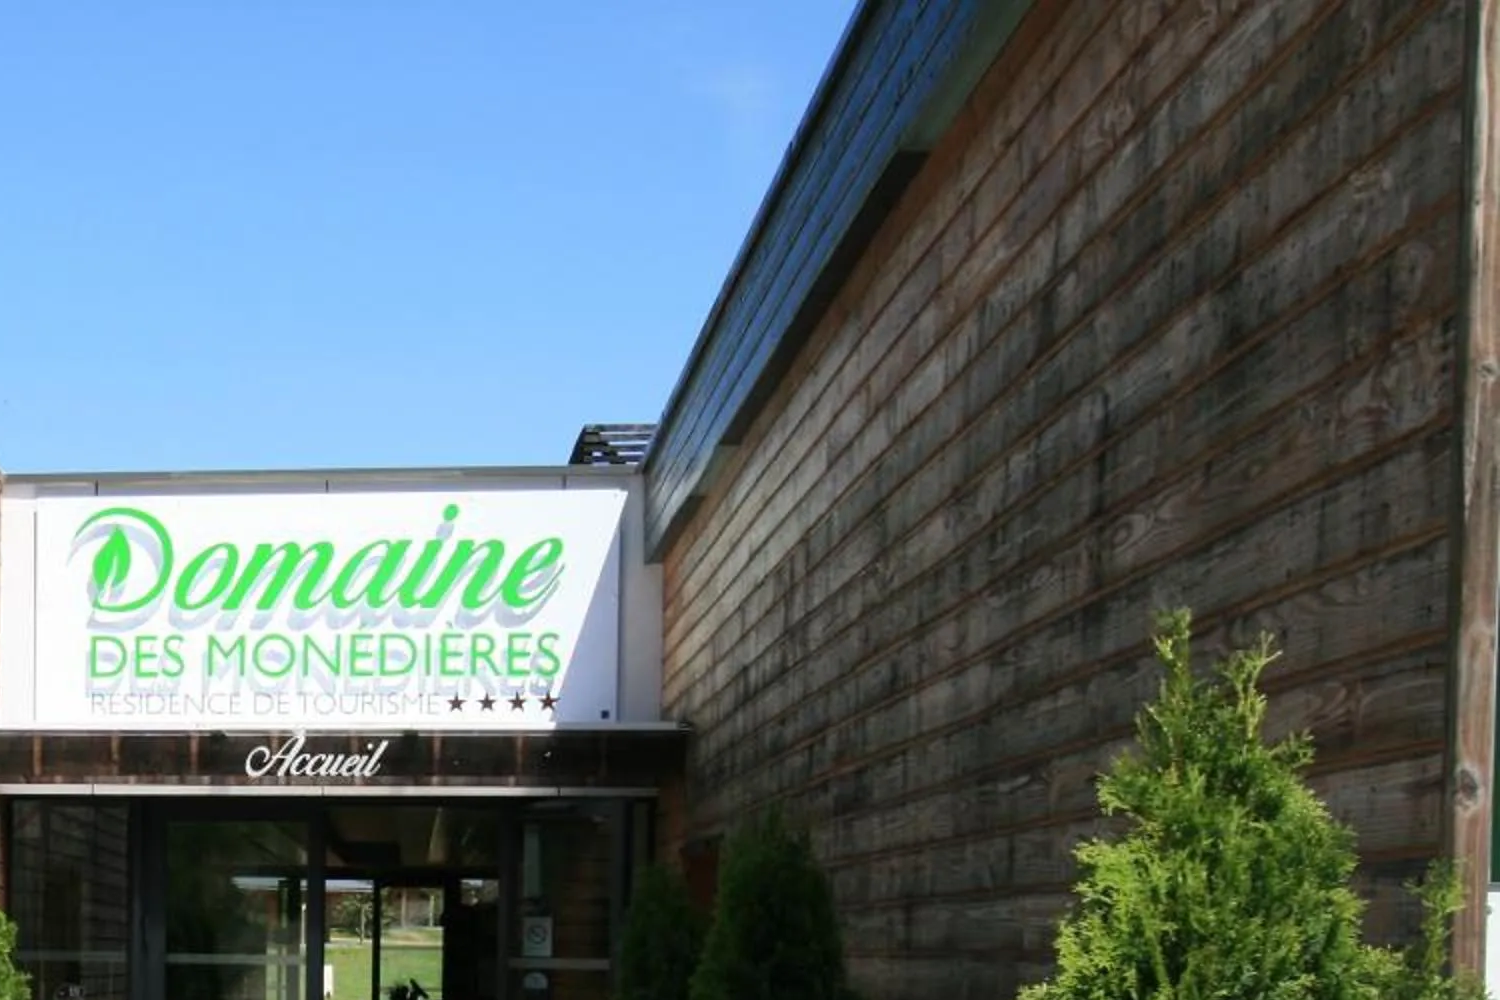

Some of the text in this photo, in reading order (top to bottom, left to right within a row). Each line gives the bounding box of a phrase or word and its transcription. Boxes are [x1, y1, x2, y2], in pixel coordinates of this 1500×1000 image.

[74, 504, 562, 612] Domaine
[90, 622, 562, 678] DES MONÉDIÈRES
[253, 692, 290, 715] DE
[298, 691, 441, 715] TOURISME
[245, 730, 389, 777] Accueil
